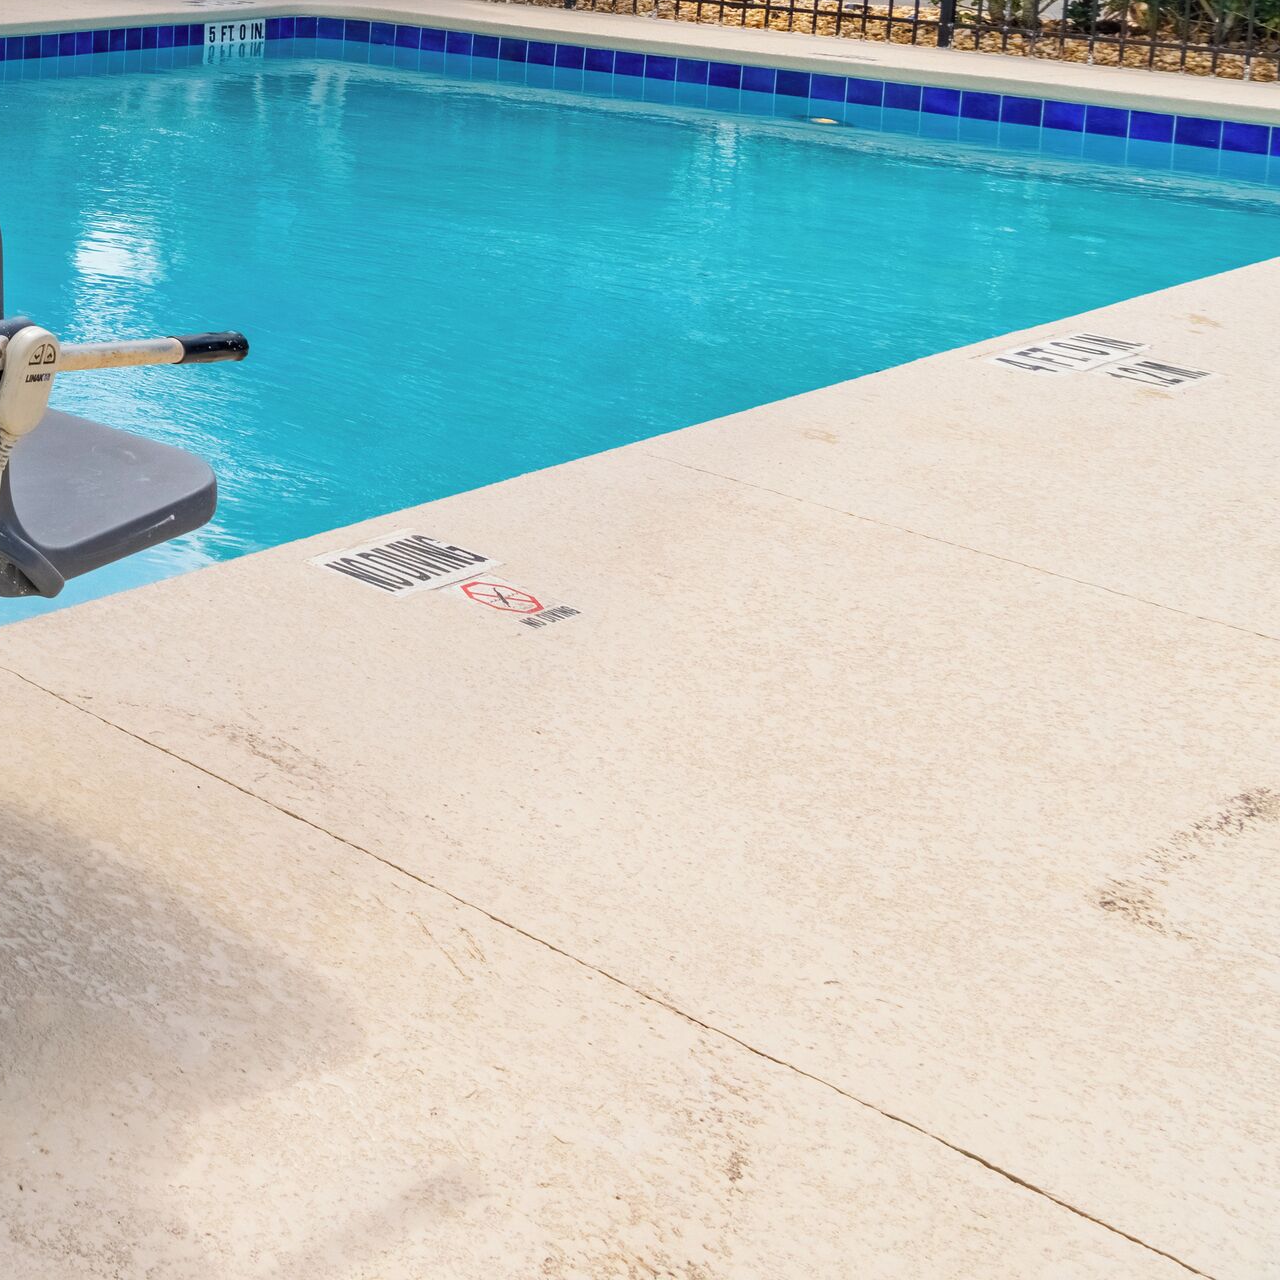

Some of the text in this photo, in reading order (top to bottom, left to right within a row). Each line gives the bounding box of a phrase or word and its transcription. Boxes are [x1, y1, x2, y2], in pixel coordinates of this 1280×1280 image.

[209, 26, 216, 43] 5
[251, 23, 264, 40] IN.
[324, 534, 489, 593] NO DIVING
[519, 605, 582, 629] NO DIVING
